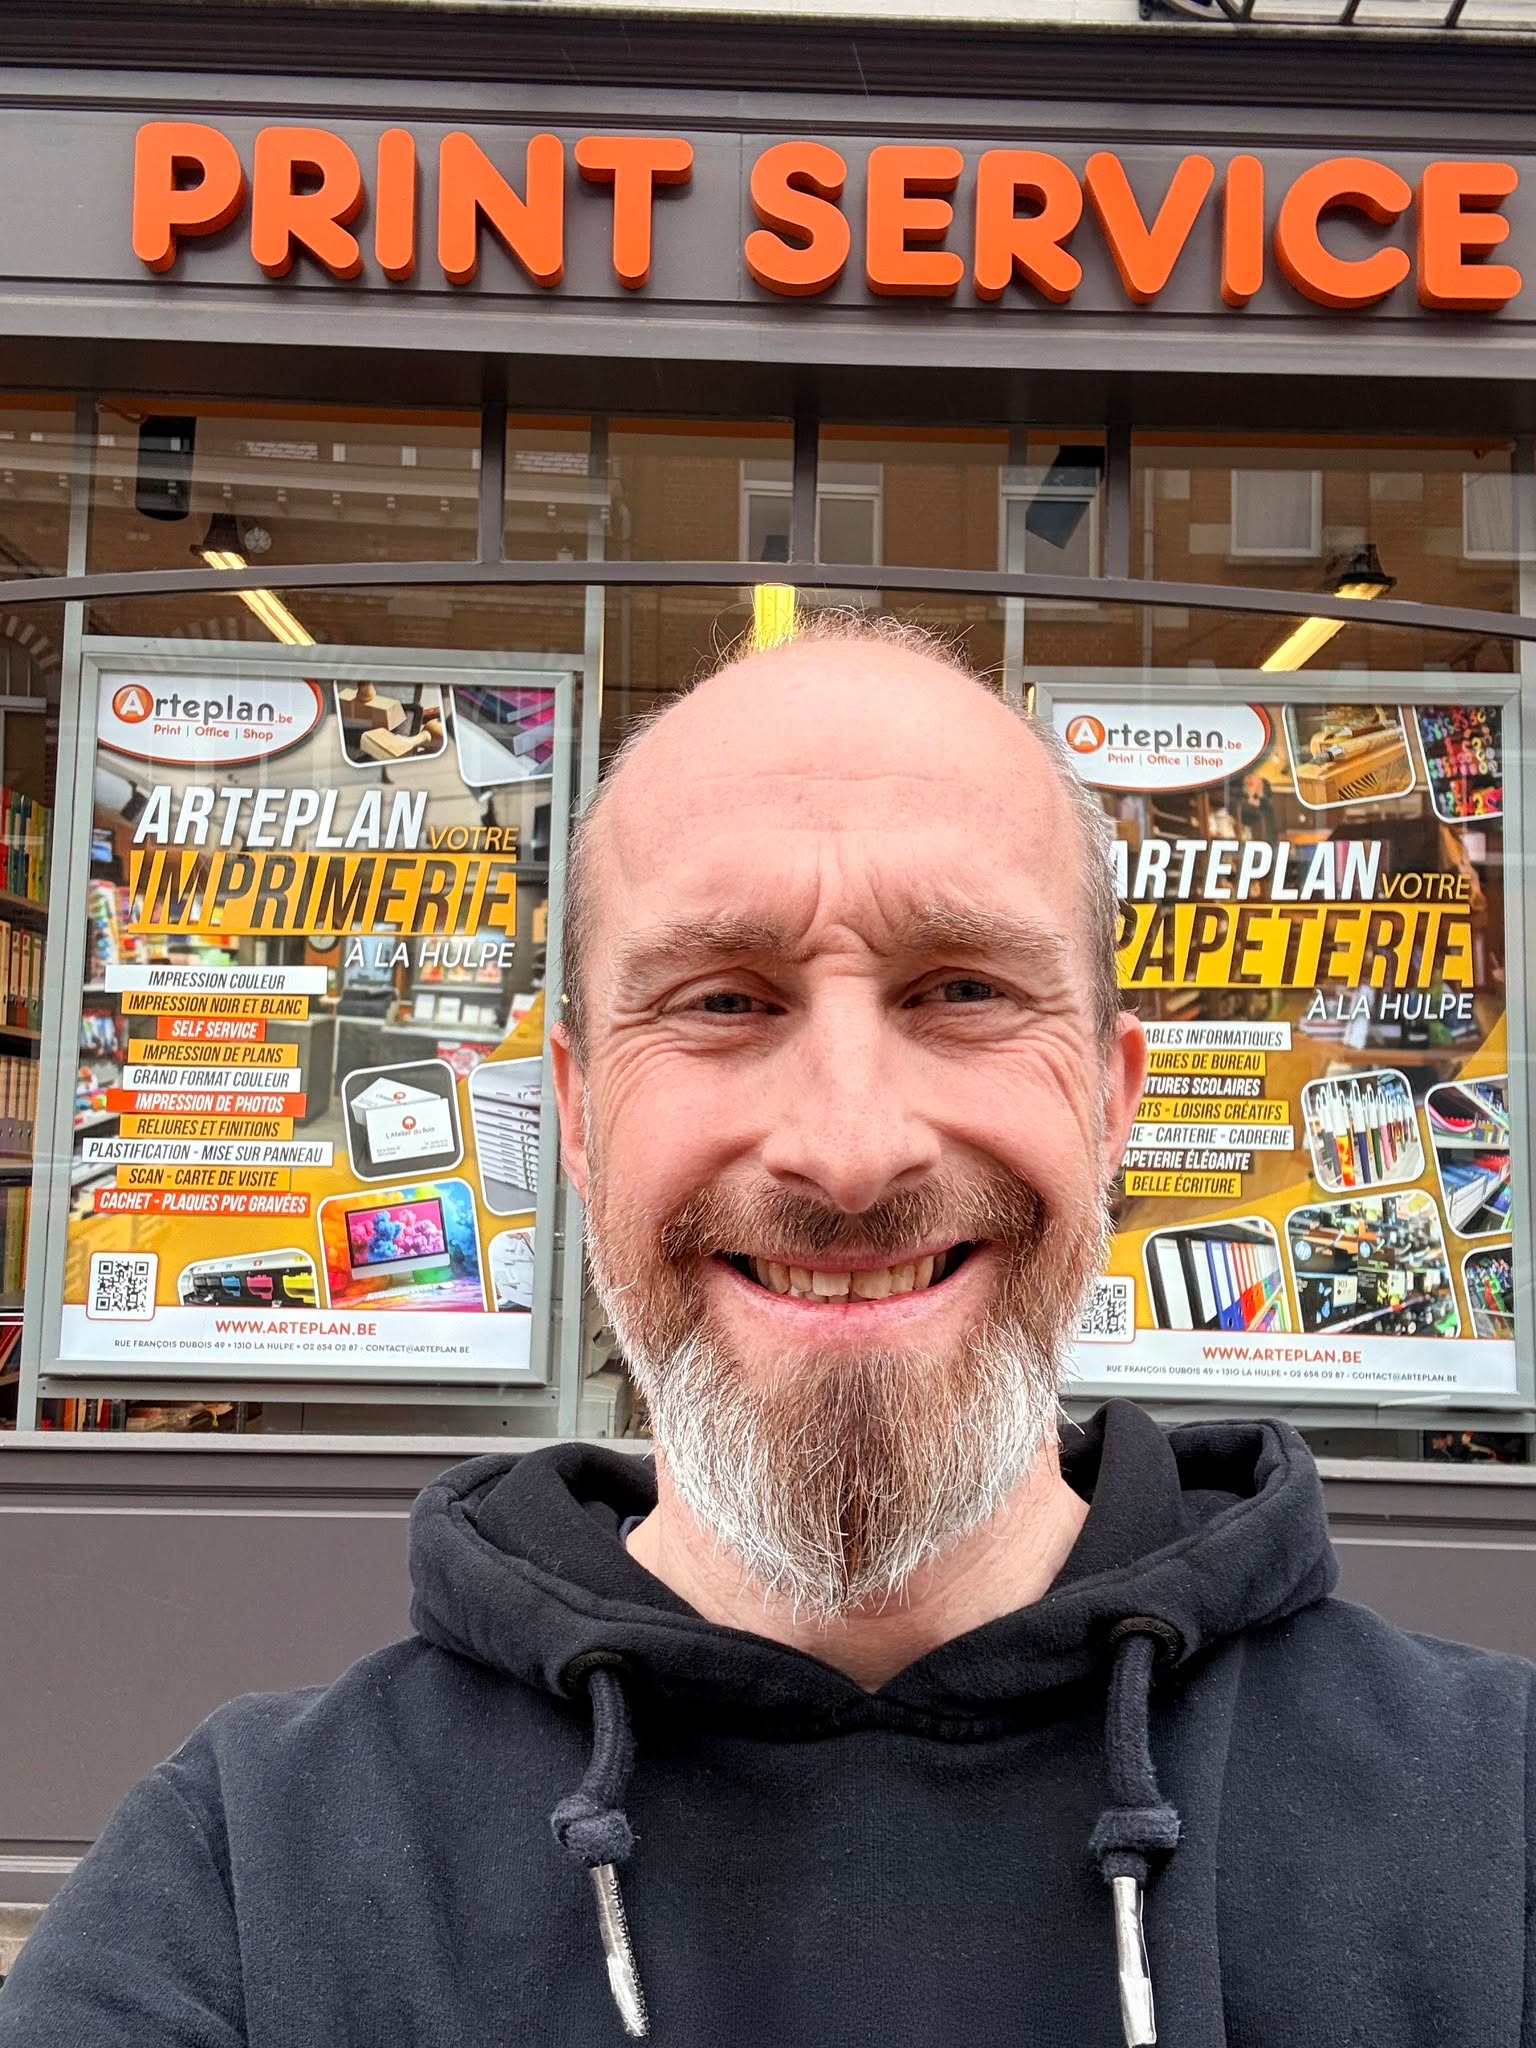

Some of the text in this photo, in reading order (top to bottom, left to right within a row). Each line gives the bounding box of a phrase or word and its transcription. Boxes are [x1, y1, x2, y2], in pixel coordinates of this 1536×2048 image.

[133, 121, 1523, 310] PRINT SERVICE
[154, 724, 273, 742] Print Office Shop
[1108, 754, 1223, 768] Print Office Shop
[133, 785, 519, 851] ARTEPLAN VOTRE
[1108, 839, 1472, 900] ARTEPLAN VOTRE
[130, 851, 517, 937] IMPRIMERIE
[345, 937, 516, 968] À LA HULPE
[149, 970, 285, 990] IMPRESSION COULEUR
[128, 994, 302, 1015] IMPRESSION NOIR ET BLANC
[1307, 988, 1474, 1020] À LA HULPE
[171, 1020, 259, 1039] SELF SERVICE
[1186, 1028, 1283, 1047] INFORMATIQUES
[142, 1044, 283, 1063] IMPRESSION DE PLANS
[1191, 1053, 1210, 1070] DE
[1210, 1054, 1261, 1071] BUREAU
[132, 1068, 289, 1088] GRAND FORMAT COULEUR
[1192, 1077, 1261, 1096] SCOLAIRES
[135, 1093, 285, 1113] IMPRESSION DE PHOTOS
[1173, 1102, 1222, 1119] LOISIRS
[1224, 1100, 1282, 1120] CRÉATIFS
[136, 1118, 280, 1137] RELIURES ET FINITIONS
[1155, 1126, 1217, 1144] CARTERIE
[1229, 1128, 1291, 1145] CADRERIE
[89, 1142, 191, 1160] PLASTIFICATION
[201, 1145, 232, 1161] MISE
[234, 1146, 261, 1162] SUR
[262, 1146, 323, 1163] PANNEAU
[1185, 1148, 1251, 1171] ÉLÉGANTE
[129, 1168, 163, 1185] SCAN
[175, 1170, 216, 1186] CARTE
[218, 1170, 236, 1187] DE
[239, 1171, 278, 1187] VISITE
[1132, 1173, 1236, 1194] BELLE ÉCRITURE
[100, 1192, 152, 1209] CACHET
[161, 1193, 221, 1212] PLAQUES
[221, 1195, 247, 1212] PVC
[248, 1192, 307, 1213] GRAVÉES
[215, 1320, 377, 1336] WWW.ARTEPLAN.BE
[114, 1339, 131, 1348] RUE
[133, 1339, 177, 1350] FRANÇOIS
[179, 1340, 212, 1349] DUBOIS
[214, 1341, 224, 1349] 49
[254, 1342, 265, 1350] LA
[267, 1342, 294, 1351] HULPE
[1203, 1347, 1361, 1363] WWW.ARTEPLAN.BE
[1106, 1364, 1122, 1373] RUE
[1169, 1367, 1200, 1376] DUBOIS
[1242, 1368, 1252, 1377] LA
[1254, 1369, 1281, 1377] HULPE
